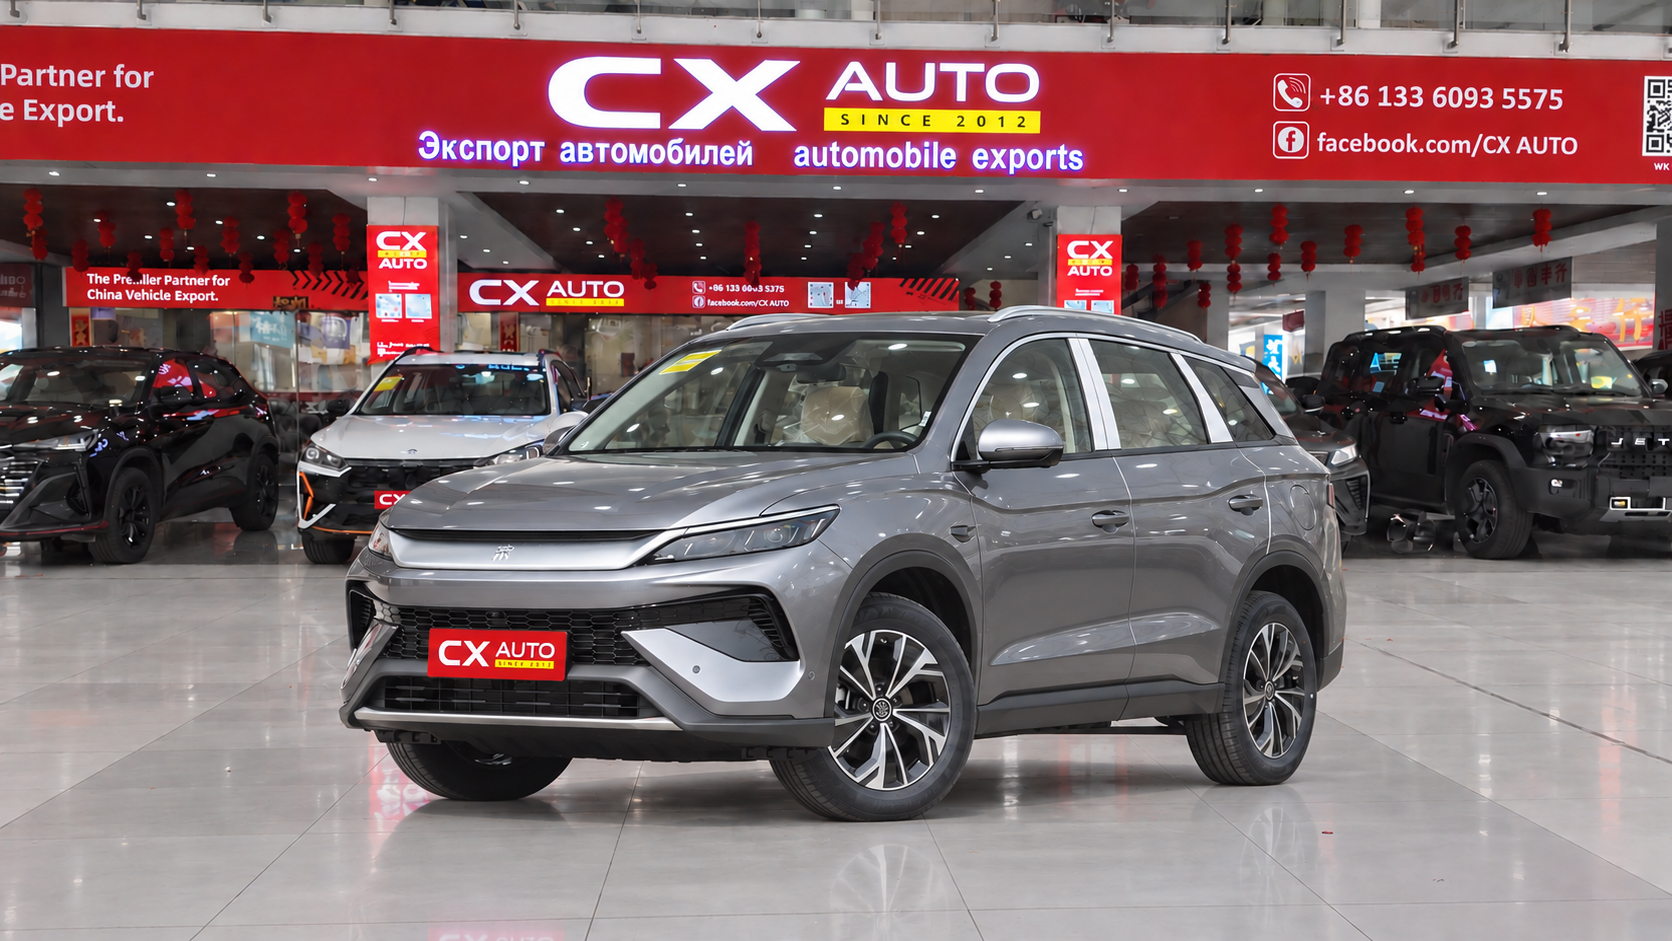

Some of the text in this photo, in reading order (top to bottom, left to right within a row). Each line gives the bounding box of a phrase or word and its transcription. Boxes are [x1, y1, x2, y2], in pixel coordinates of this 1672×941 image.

[1, 63, 154, 88] Partner for
[548, 56, 1040, 132] CX AUTO
[1320, 85, 1563, 110] +86 133 6093 5575
[0, 99, 124, 127] e Export.
[841, 113, 1026, 128] SINCE 2012
[418, 131, 754, 167] Экспорт автомобилей
[1317, 131, 1578, 158] facebook.com/CX AUTO
[793, 140, 1085, 175] automobile exports
[375, 231, 427, 252] CX
[1066, 240, 1114, 259] CX
[378, 257, 428, 270] AUTO
[1067, 265, 1113, 277] AUTO
[86, 273, 111, 285] The
[164, 274, 210, 287] Partner
[211, 274, 231, 287] for
[469, 279, 625, 306] CX AUTO
[86, 288, 219, 304] China Vehicle Export.
[769, 299, 790, 307] AUTO
[438, 639, 556, 668] CX AUTO
